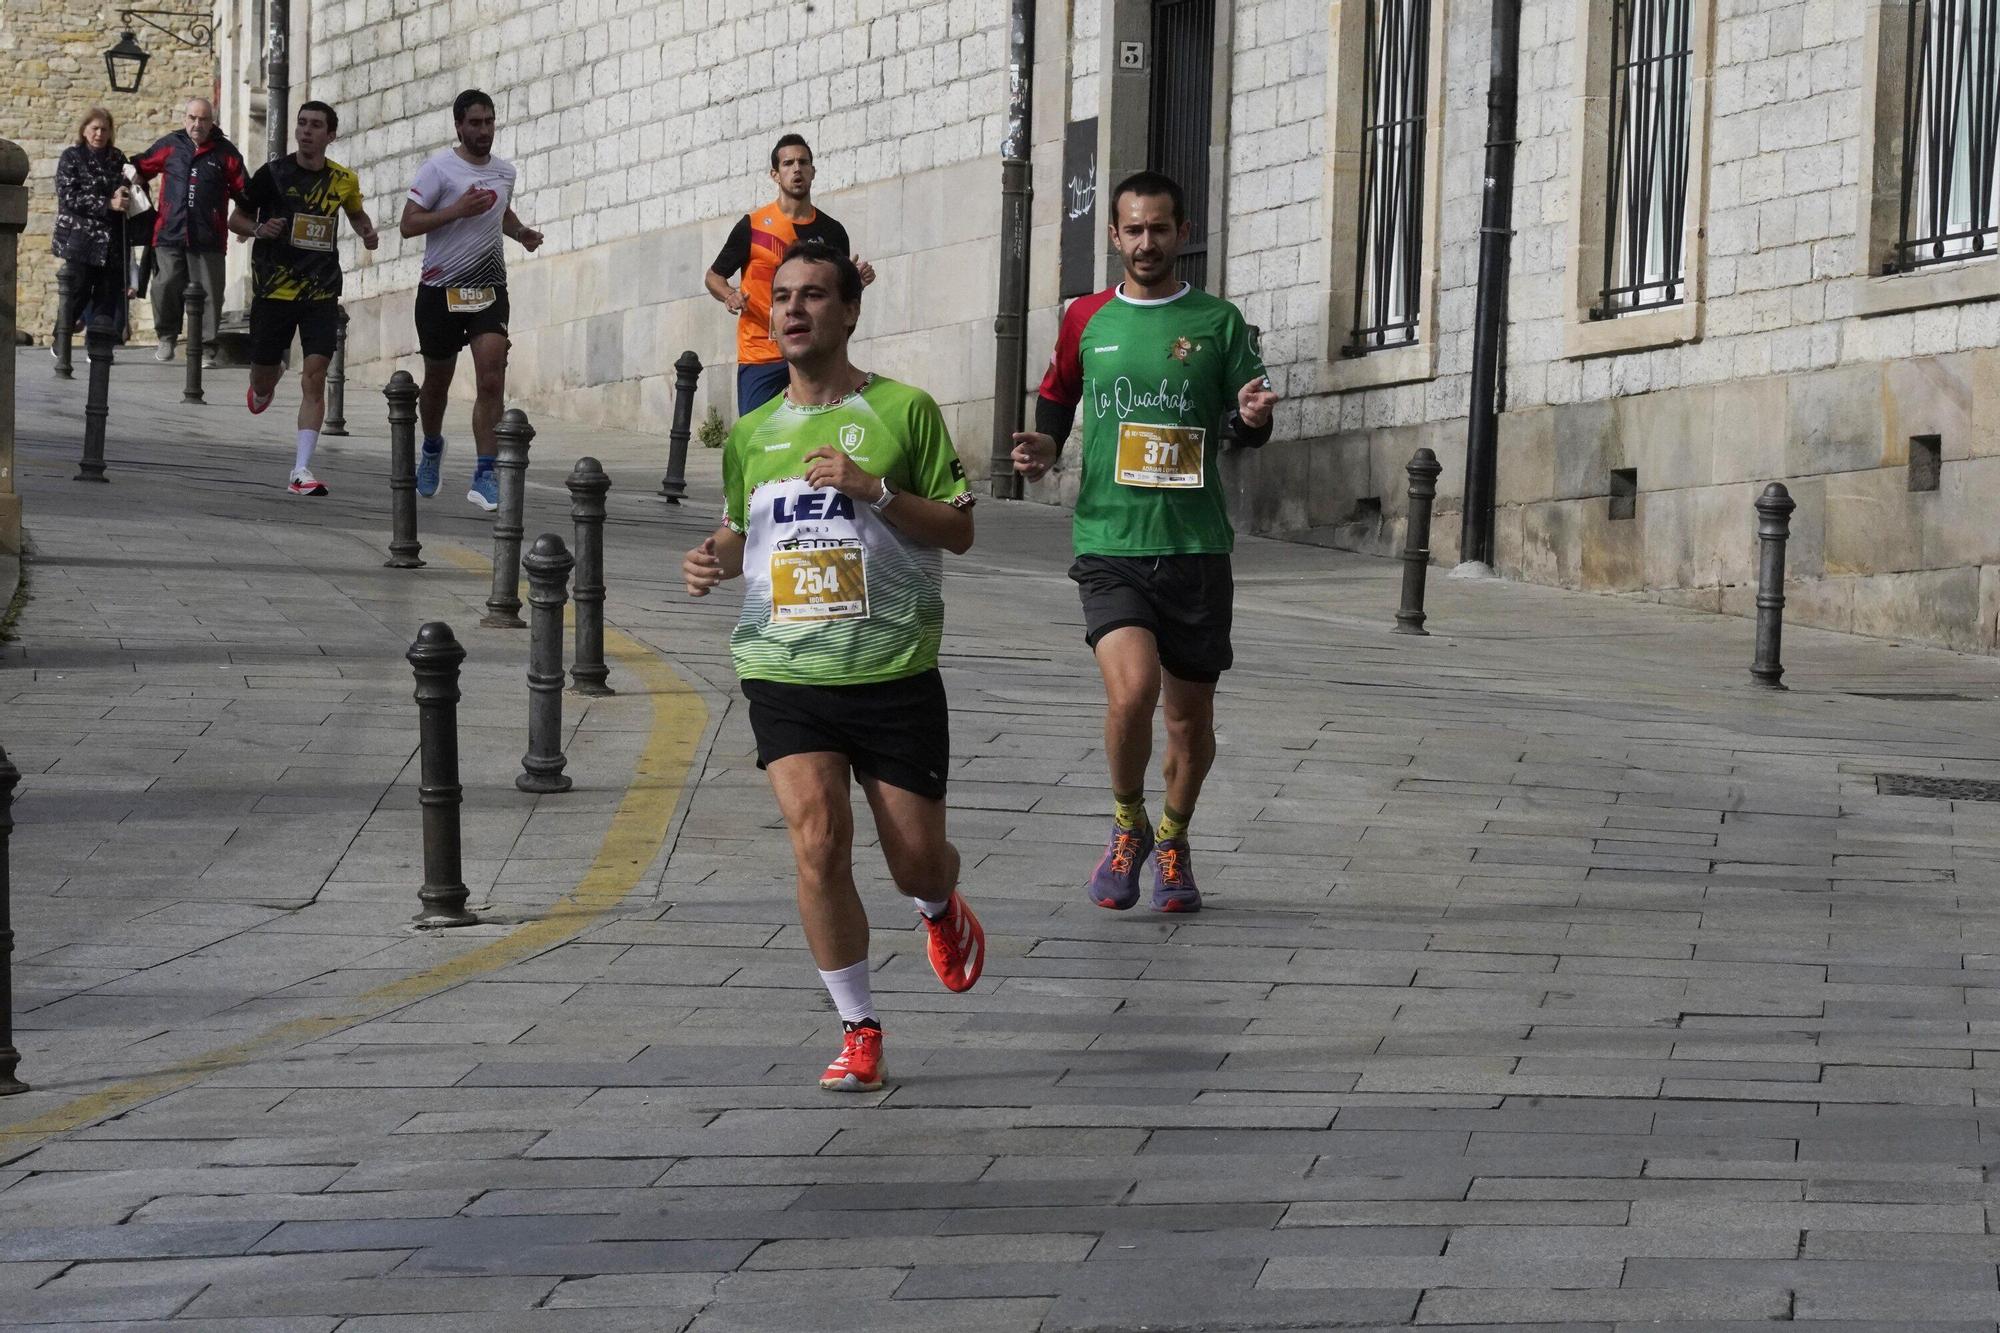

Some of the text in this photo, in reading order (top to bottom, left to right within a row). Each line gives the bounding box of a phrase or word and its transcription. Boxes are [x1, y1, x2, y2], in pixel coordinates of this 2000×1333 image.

[306, 223, 327, 238] 327
[1144, 440, 1180, 465] 371
[773, 493, 856, 524] LEA
[793, 565, 840, 595] 254
